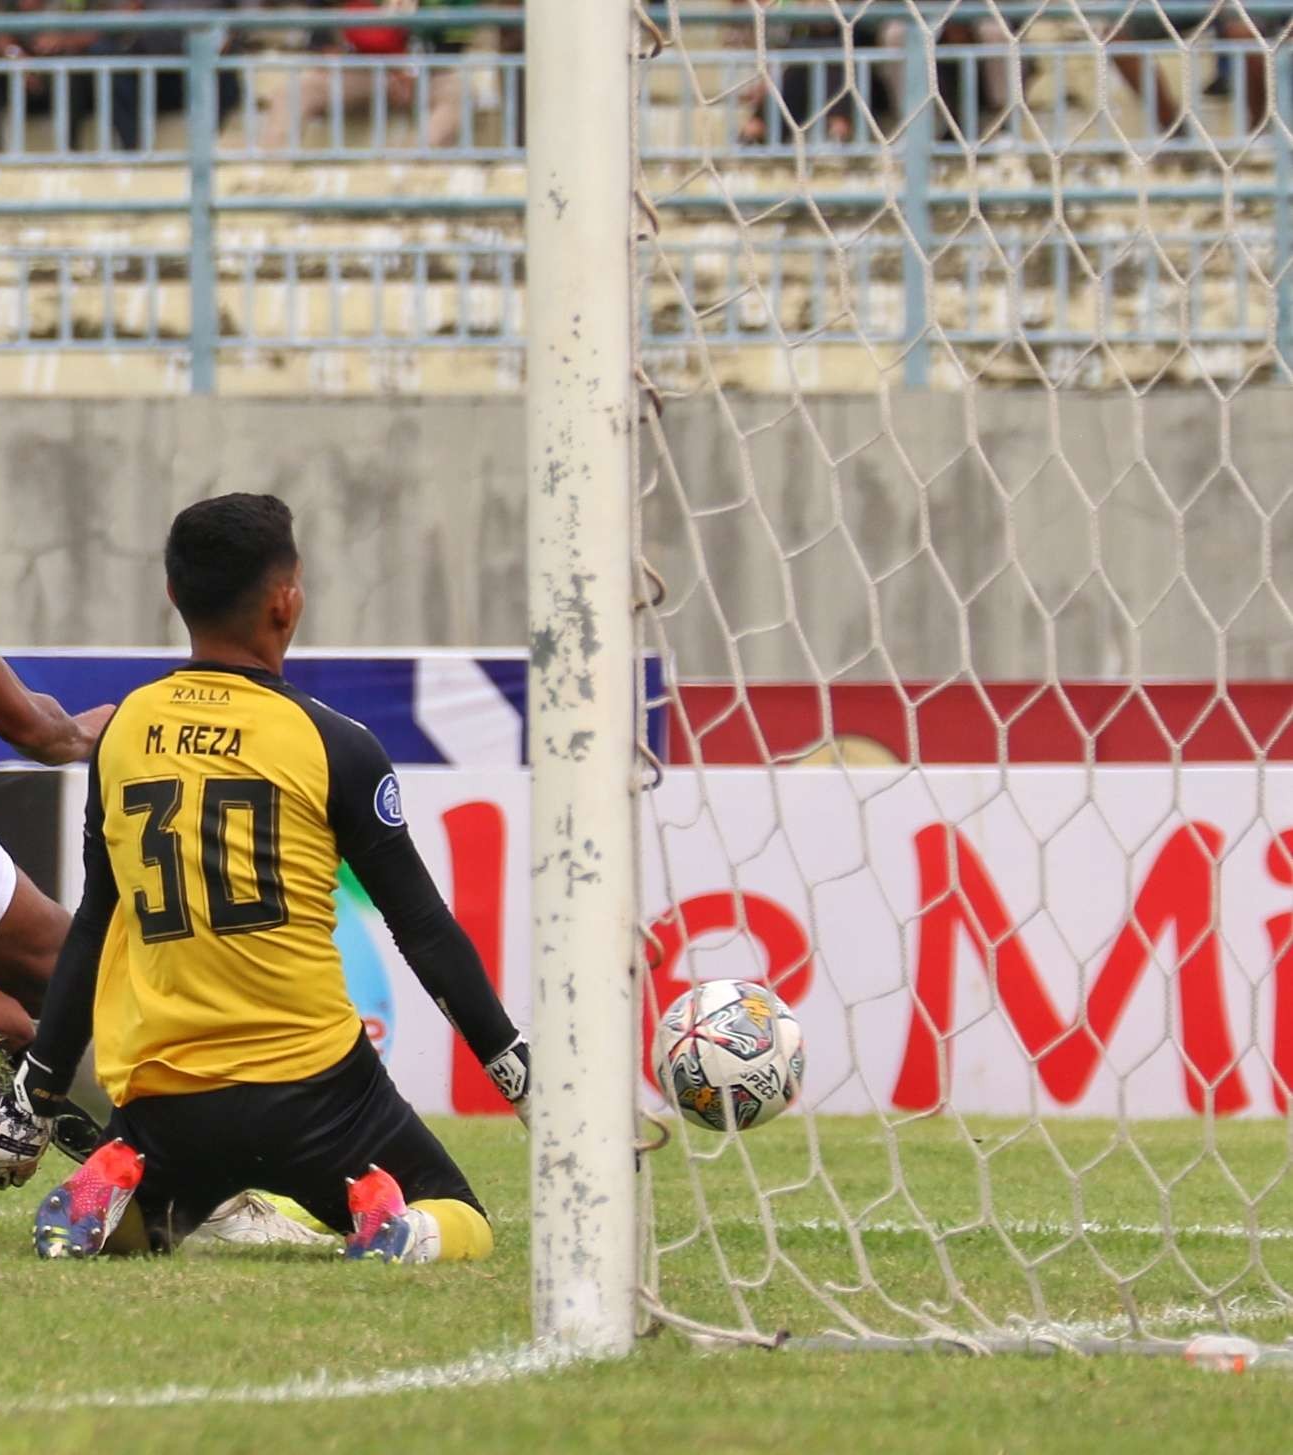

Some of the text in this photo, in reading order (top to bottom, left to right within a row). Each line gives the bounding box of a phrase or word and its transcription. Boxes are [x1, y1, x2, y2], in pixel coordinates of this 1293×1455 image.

[172, 688, 230, 701] KALLA
[146, 724, 241, 757] M. REZA
[120, 774, 290, 945] 30
[739, 1070, 778, 1100] SPECS
